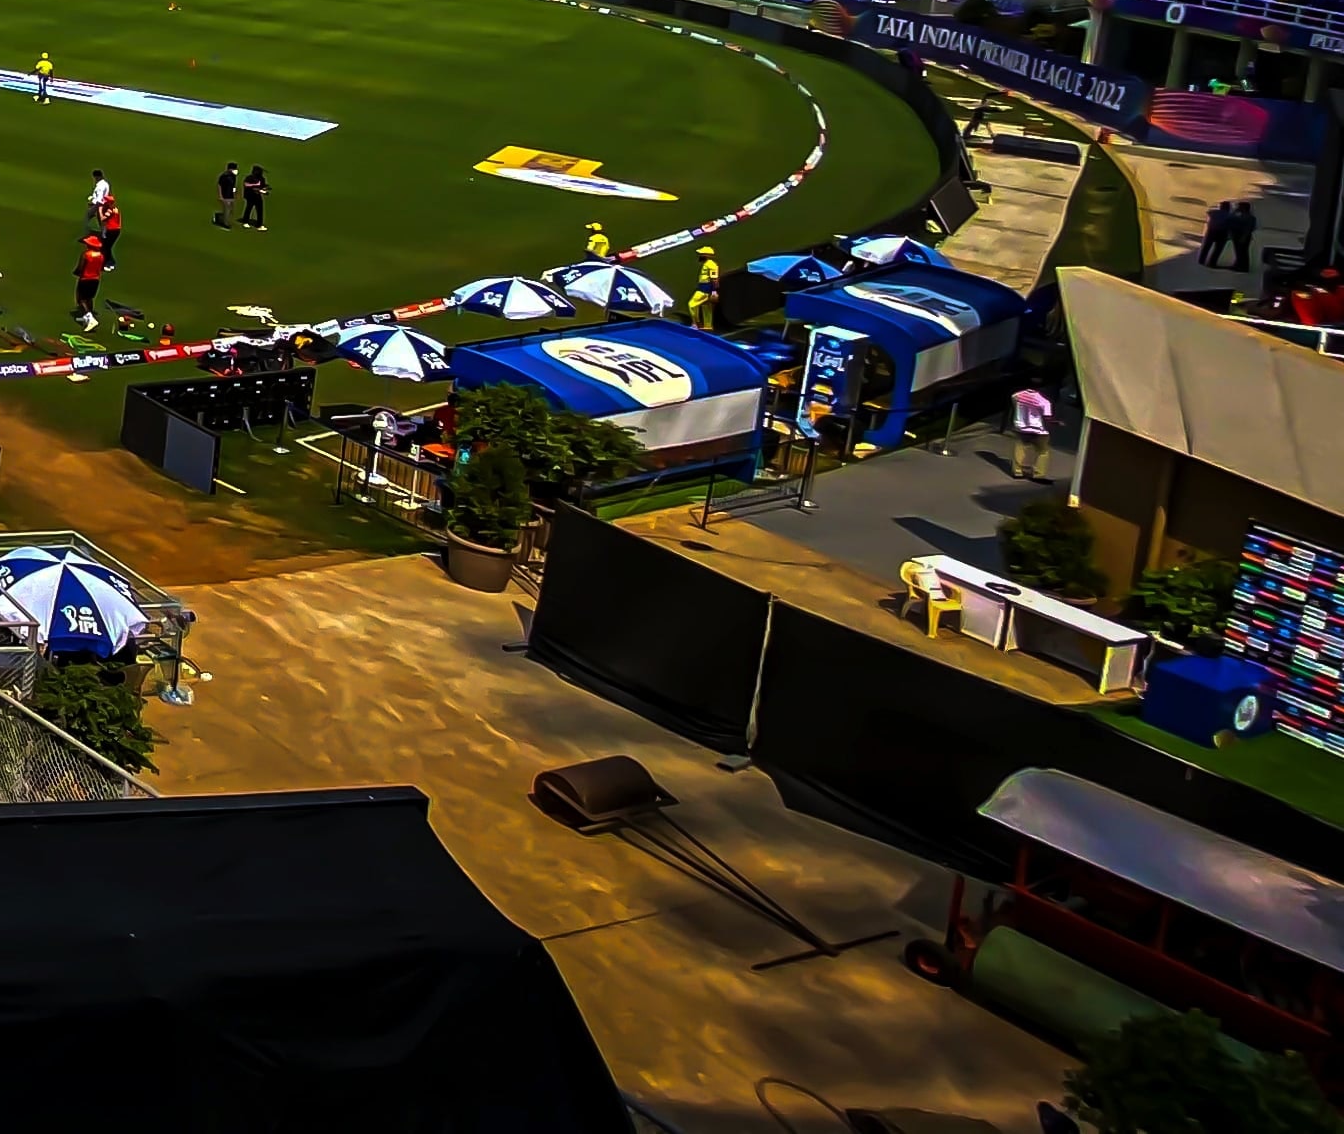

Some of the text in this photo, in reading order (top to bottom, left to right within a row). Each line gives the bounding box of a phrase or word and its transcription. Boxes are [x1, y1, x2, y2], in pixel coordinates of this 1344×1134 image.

[876, 13, 1126, 112] TATA INDIAN PREMIER LEAGUE 2022
[72, 356, 103, 370] RuPay
[618, 359, 685, 384] IPL
[78, 621, 102, 636] IPL
